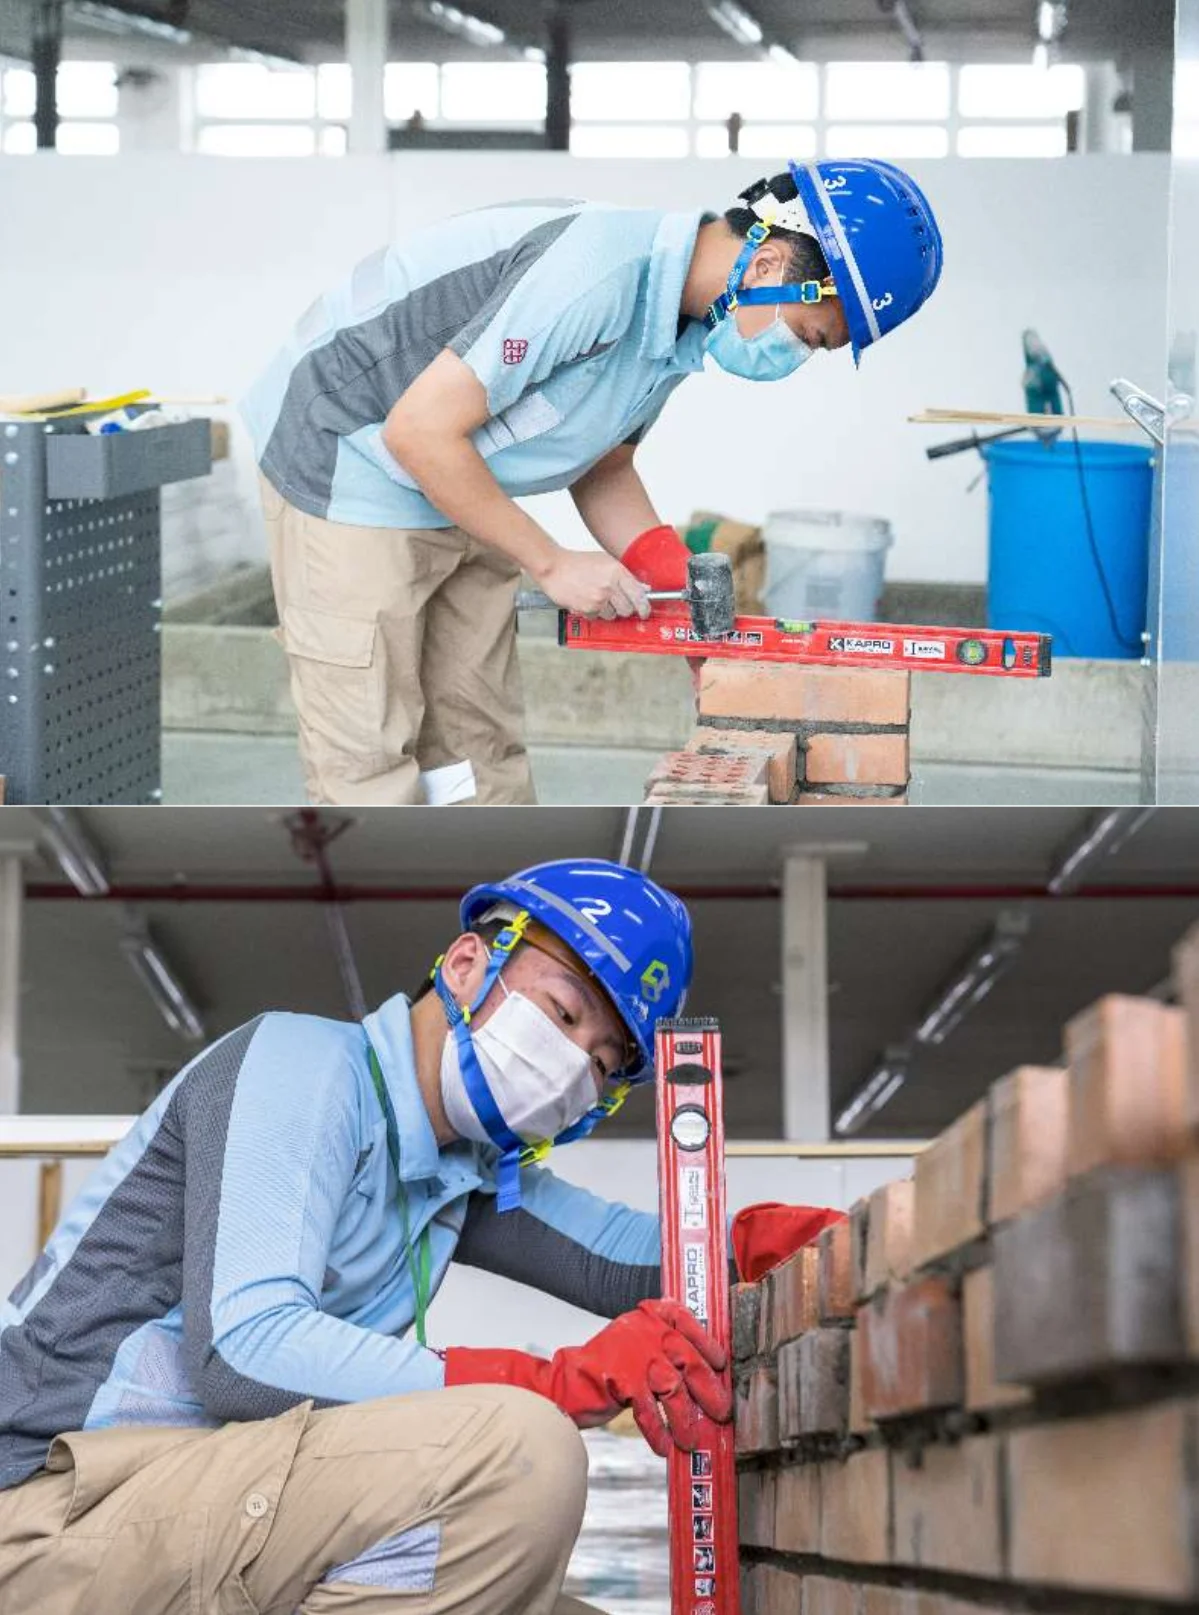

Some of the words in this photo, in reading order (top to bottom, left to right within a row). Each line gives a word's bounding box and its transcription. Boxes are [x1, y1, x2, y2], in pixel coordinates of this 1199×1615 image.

[872, 292, 894, 311] 3
[846, 639, 891, 650] KAPRO
[580, 898, 612, 925] 2
